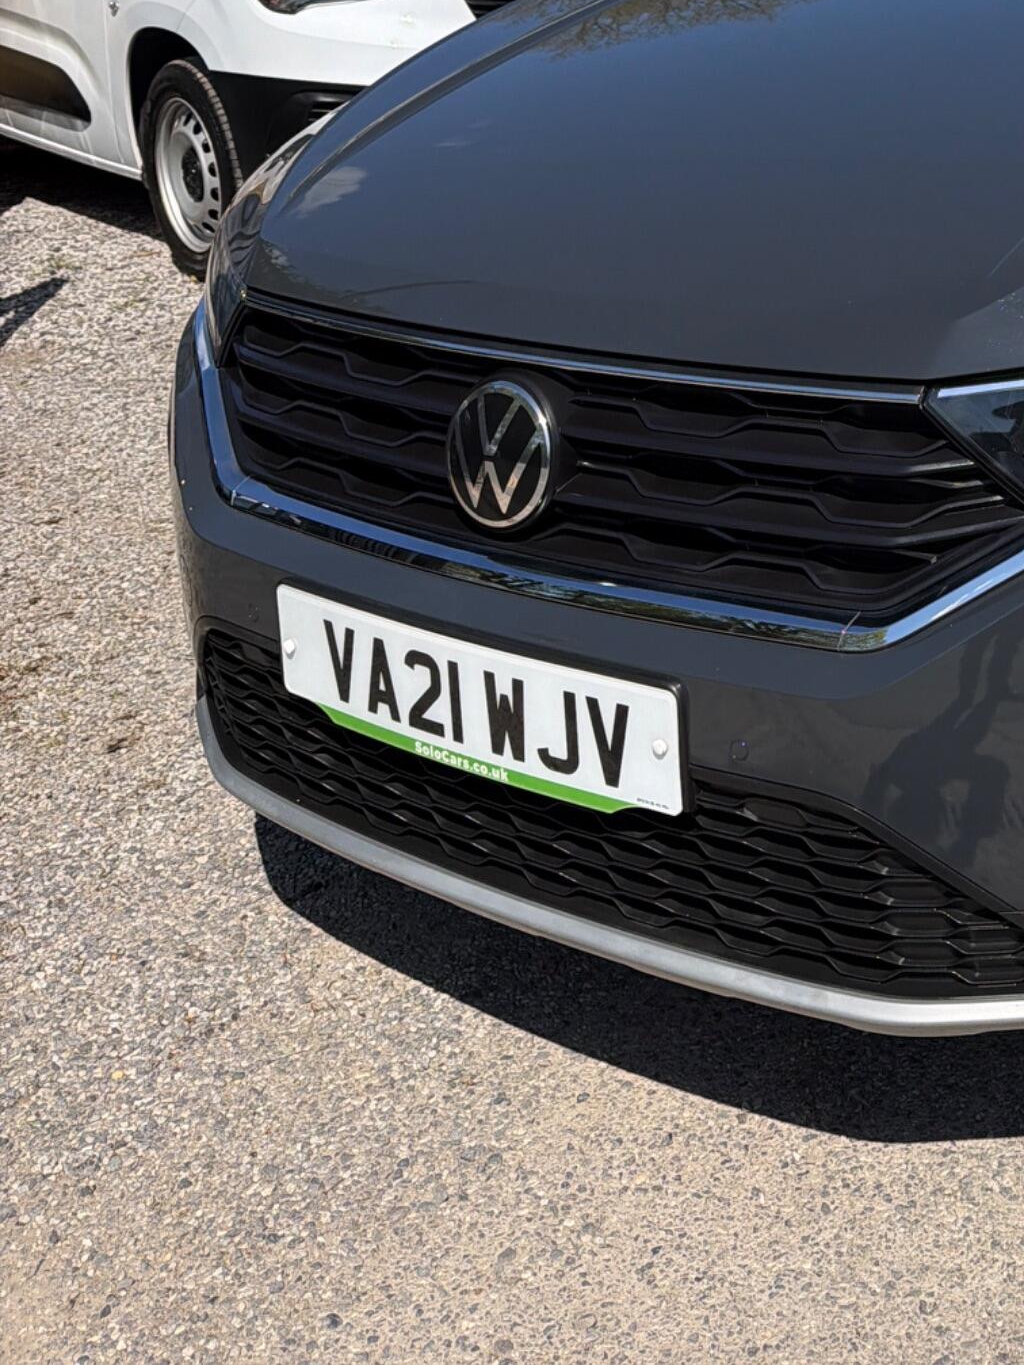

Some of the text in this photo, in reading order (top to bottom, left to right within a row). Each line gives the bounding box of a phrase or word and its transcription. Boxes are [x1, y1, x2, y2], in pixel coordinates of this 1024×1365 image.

[323, 618, 630, 789] VA21 WJV
[414, 740, 510, 783] SoloCars.co.uk
